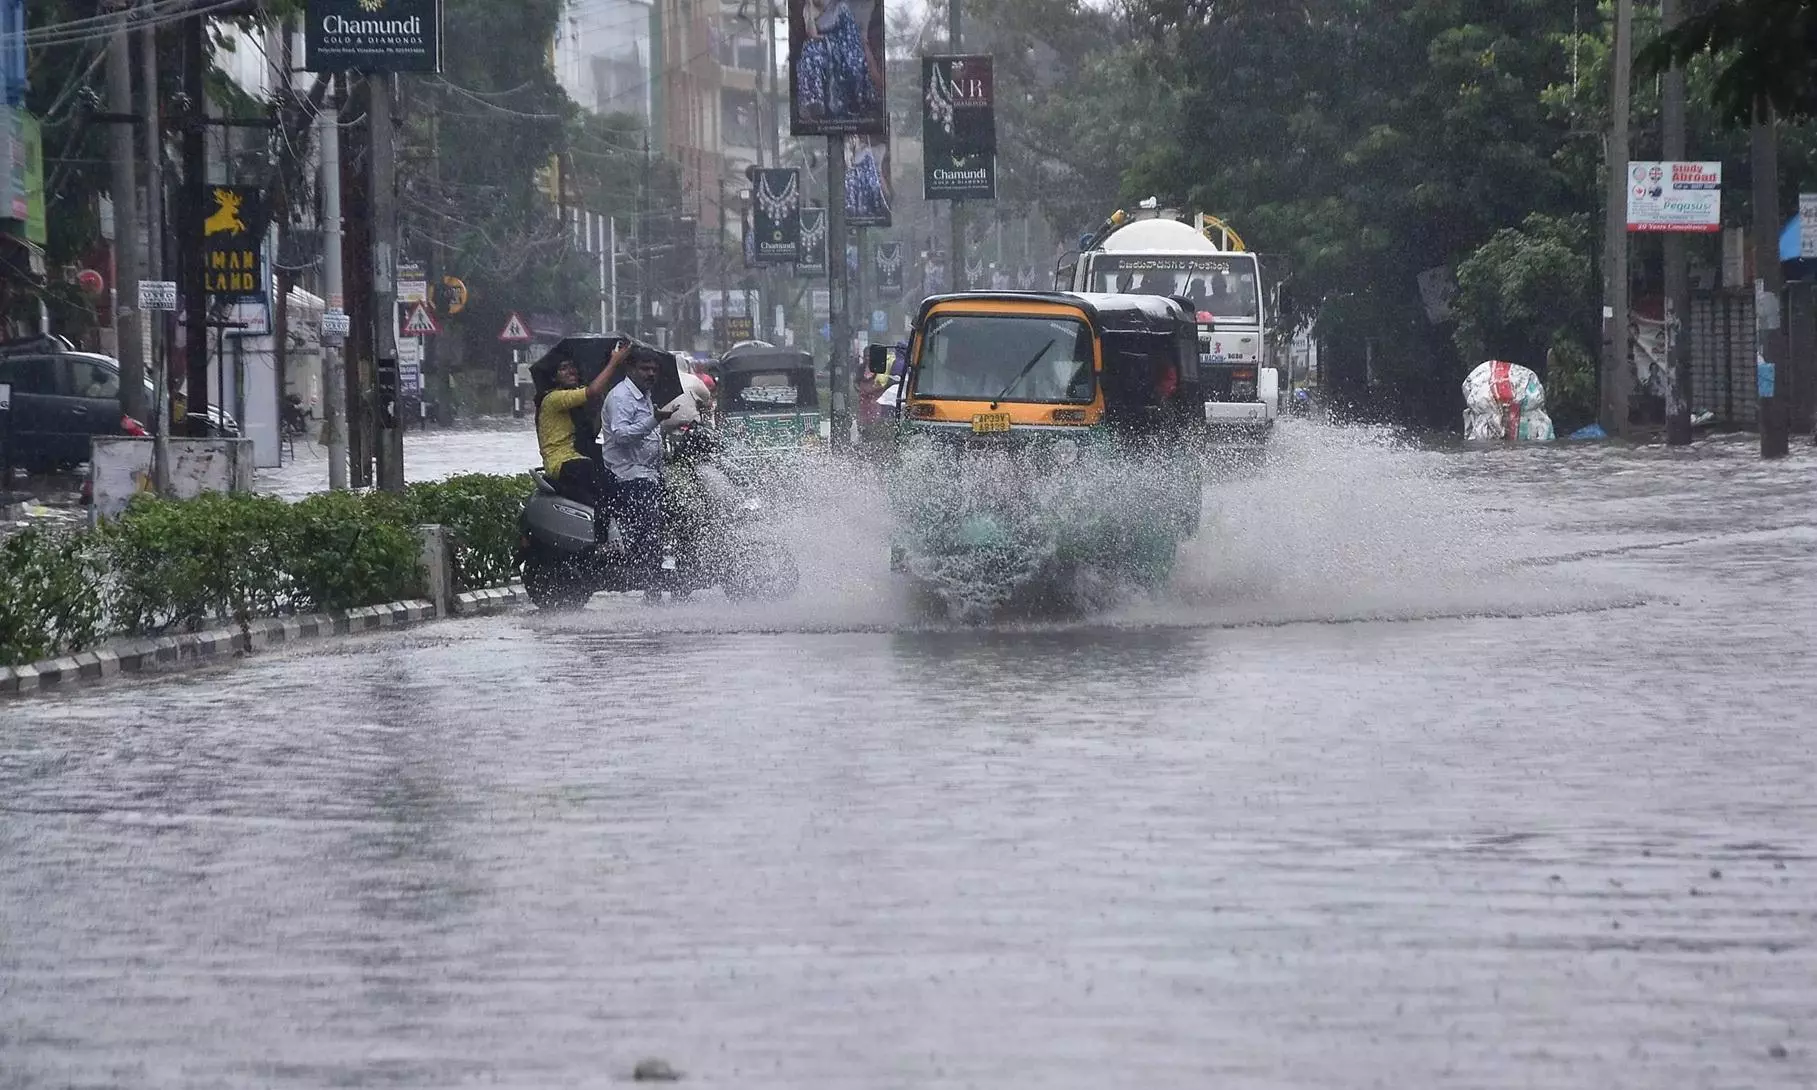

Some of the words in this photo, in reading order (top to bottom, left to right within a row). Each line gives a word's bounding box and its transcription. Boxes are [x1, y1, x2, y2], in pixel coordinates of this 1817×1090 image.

[322, 15, 421, 34] Chamundi
[323, 36, 351, 44] GOLD
[356, 36, 362, 44] &
[368, 36, 423, 44] DIAMONDS
[933, 167, 987, 180] Chamundi
[1672, 164, 1703, 174] Study
[1672, 173, 1717, 182] Abroad
